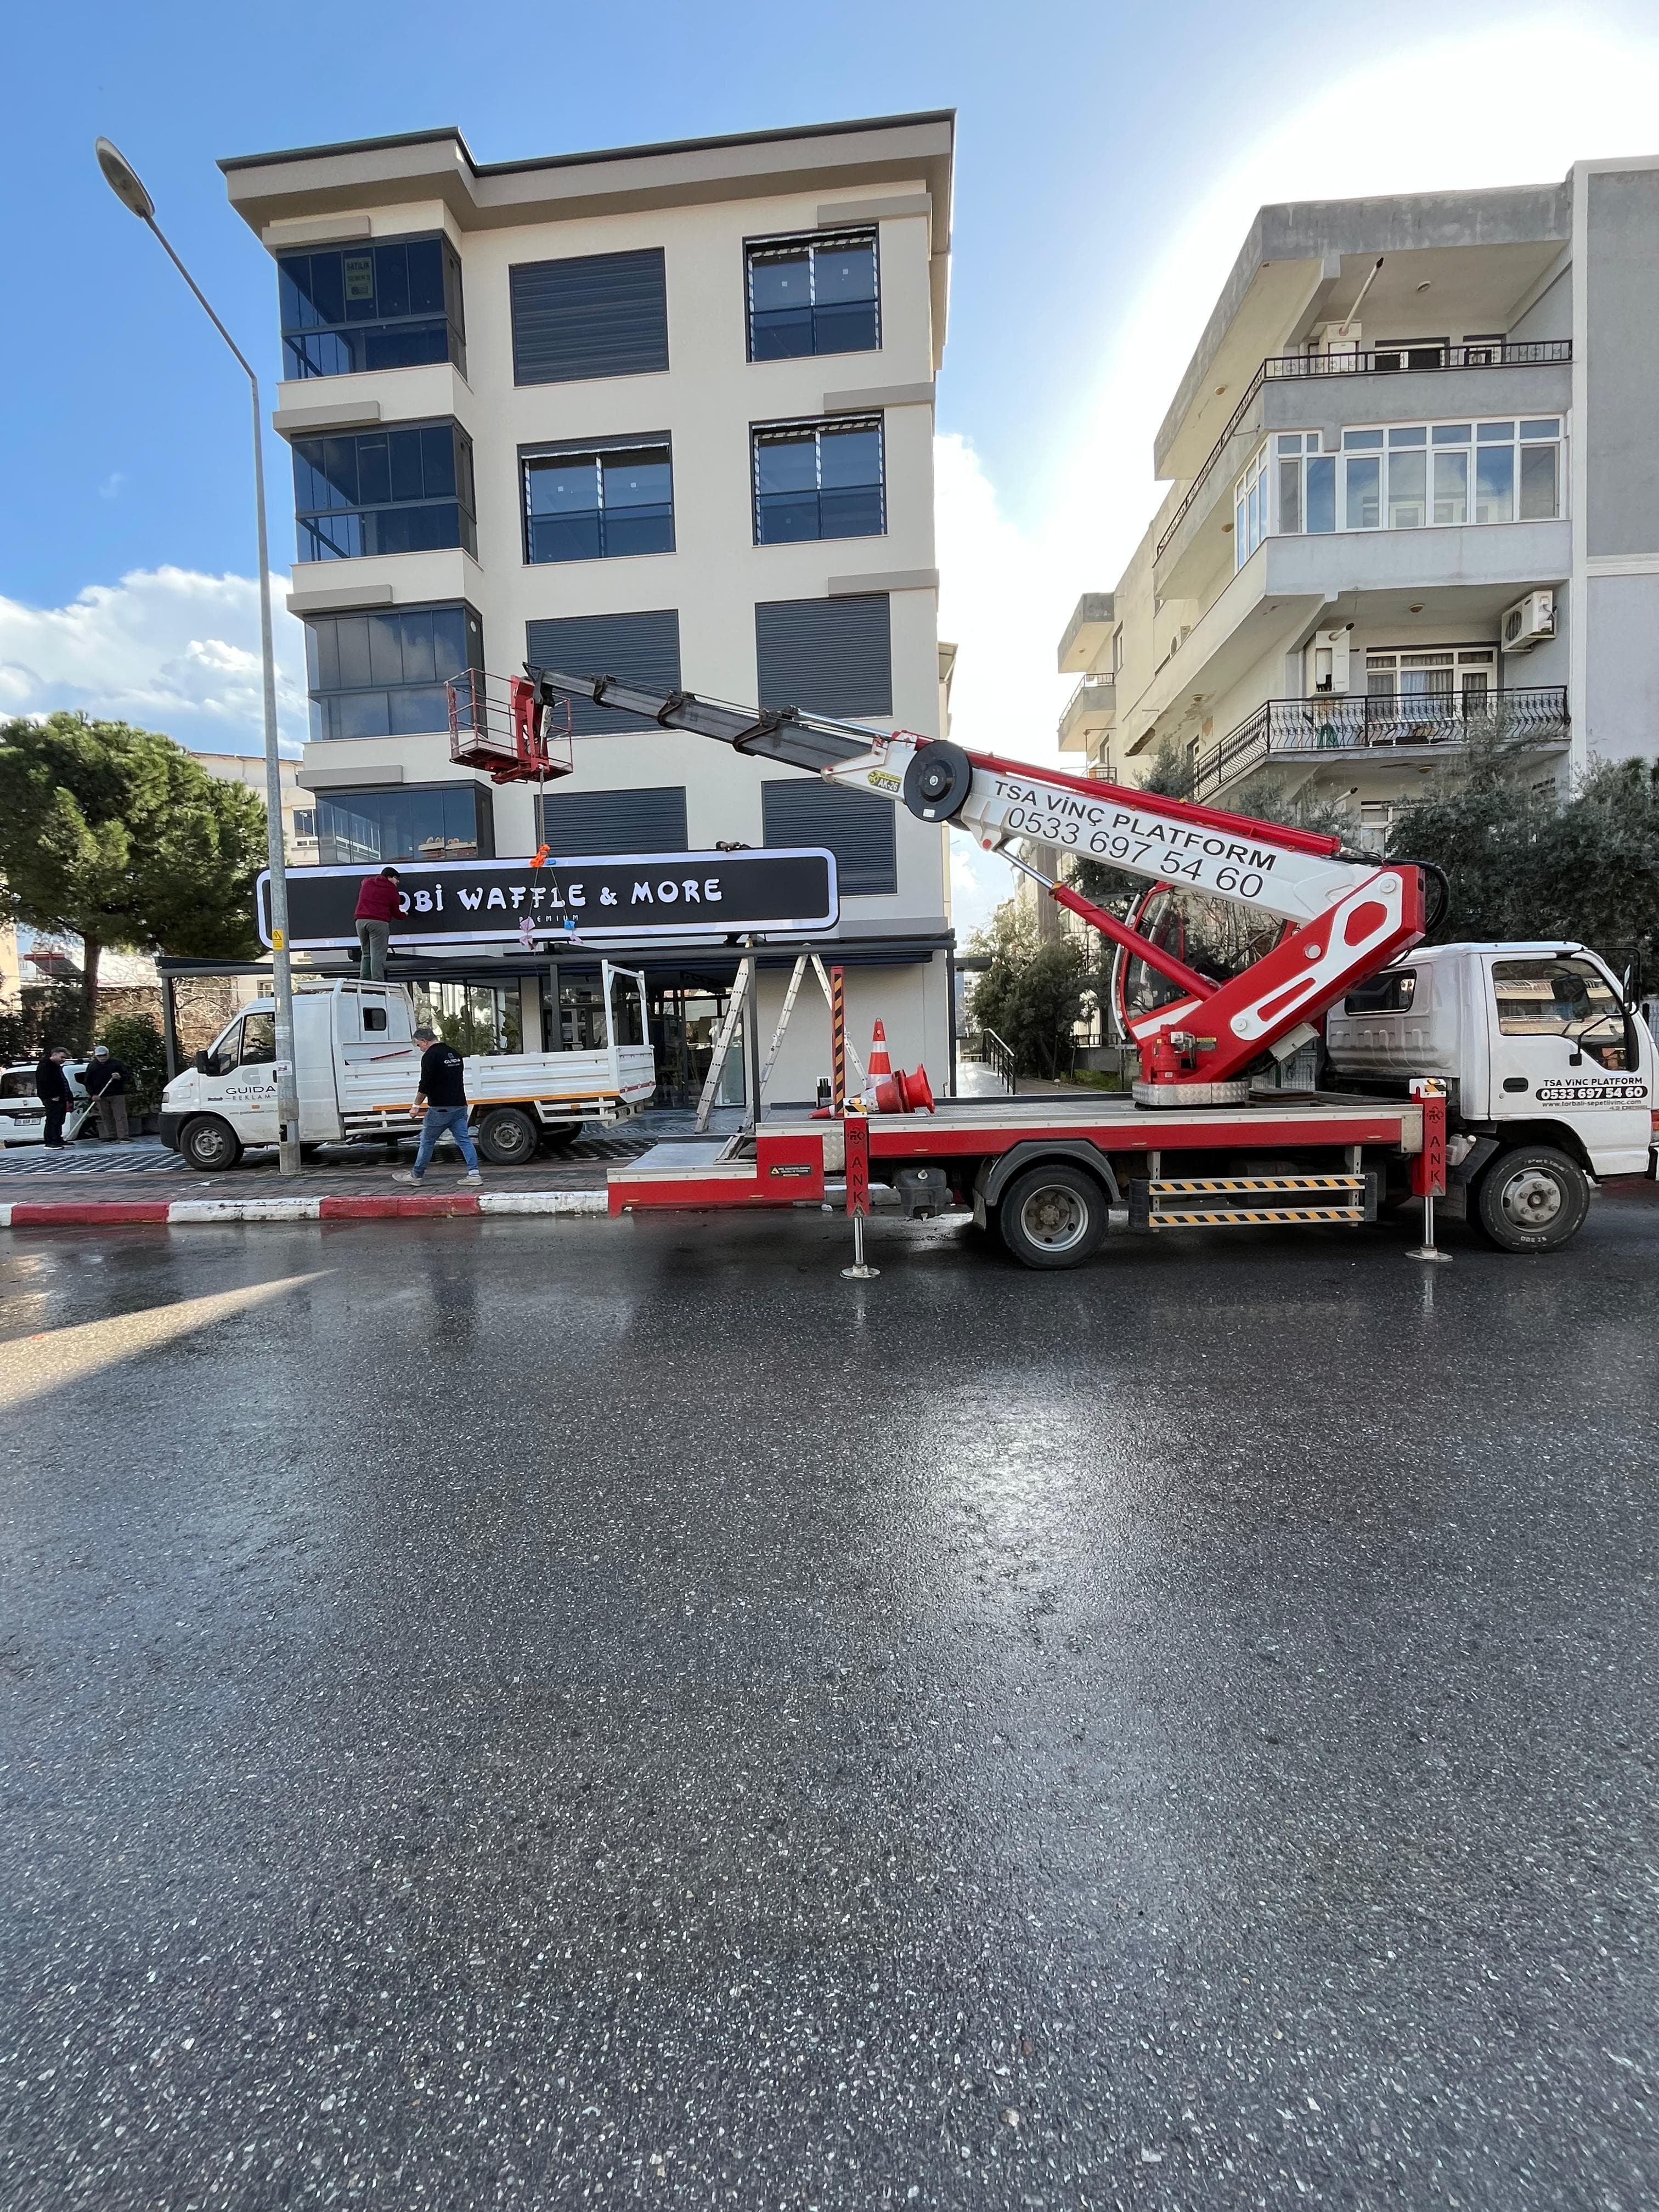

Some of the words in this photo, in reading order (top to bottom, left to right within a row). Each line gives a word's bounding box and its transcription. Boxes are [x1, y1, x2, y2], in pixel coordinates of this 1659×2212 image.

[878, 777, 898, 791] AK-26
[995, 780, 1037, 806] TSA
[1111, 813, 1277, 871] PLATFORM
[1008, 807, 1080, 844] 0533
[1090, 831, 1153, 864] 697
[1160, 850, 1203, 881] 54
[1216, 867, 1263, 898] 60
[456, 884, 586, 911] WAFFLE
[600, 887, 618, 906] &
[631, 879, 723, 905] MORE
[519, 915, 579, 923] PEMIUM
[1591, 1077, 1643, 1086] PLATFORM
[225, 1086, 276, 1094] GUIDA
[1541, 1089, 1575, 1100] 0533
[1577, 1088, 1603, 1099] 697
[1605, 1087, 1622, 1098] 54
[1625, 1087, 1643, 1097] 60
